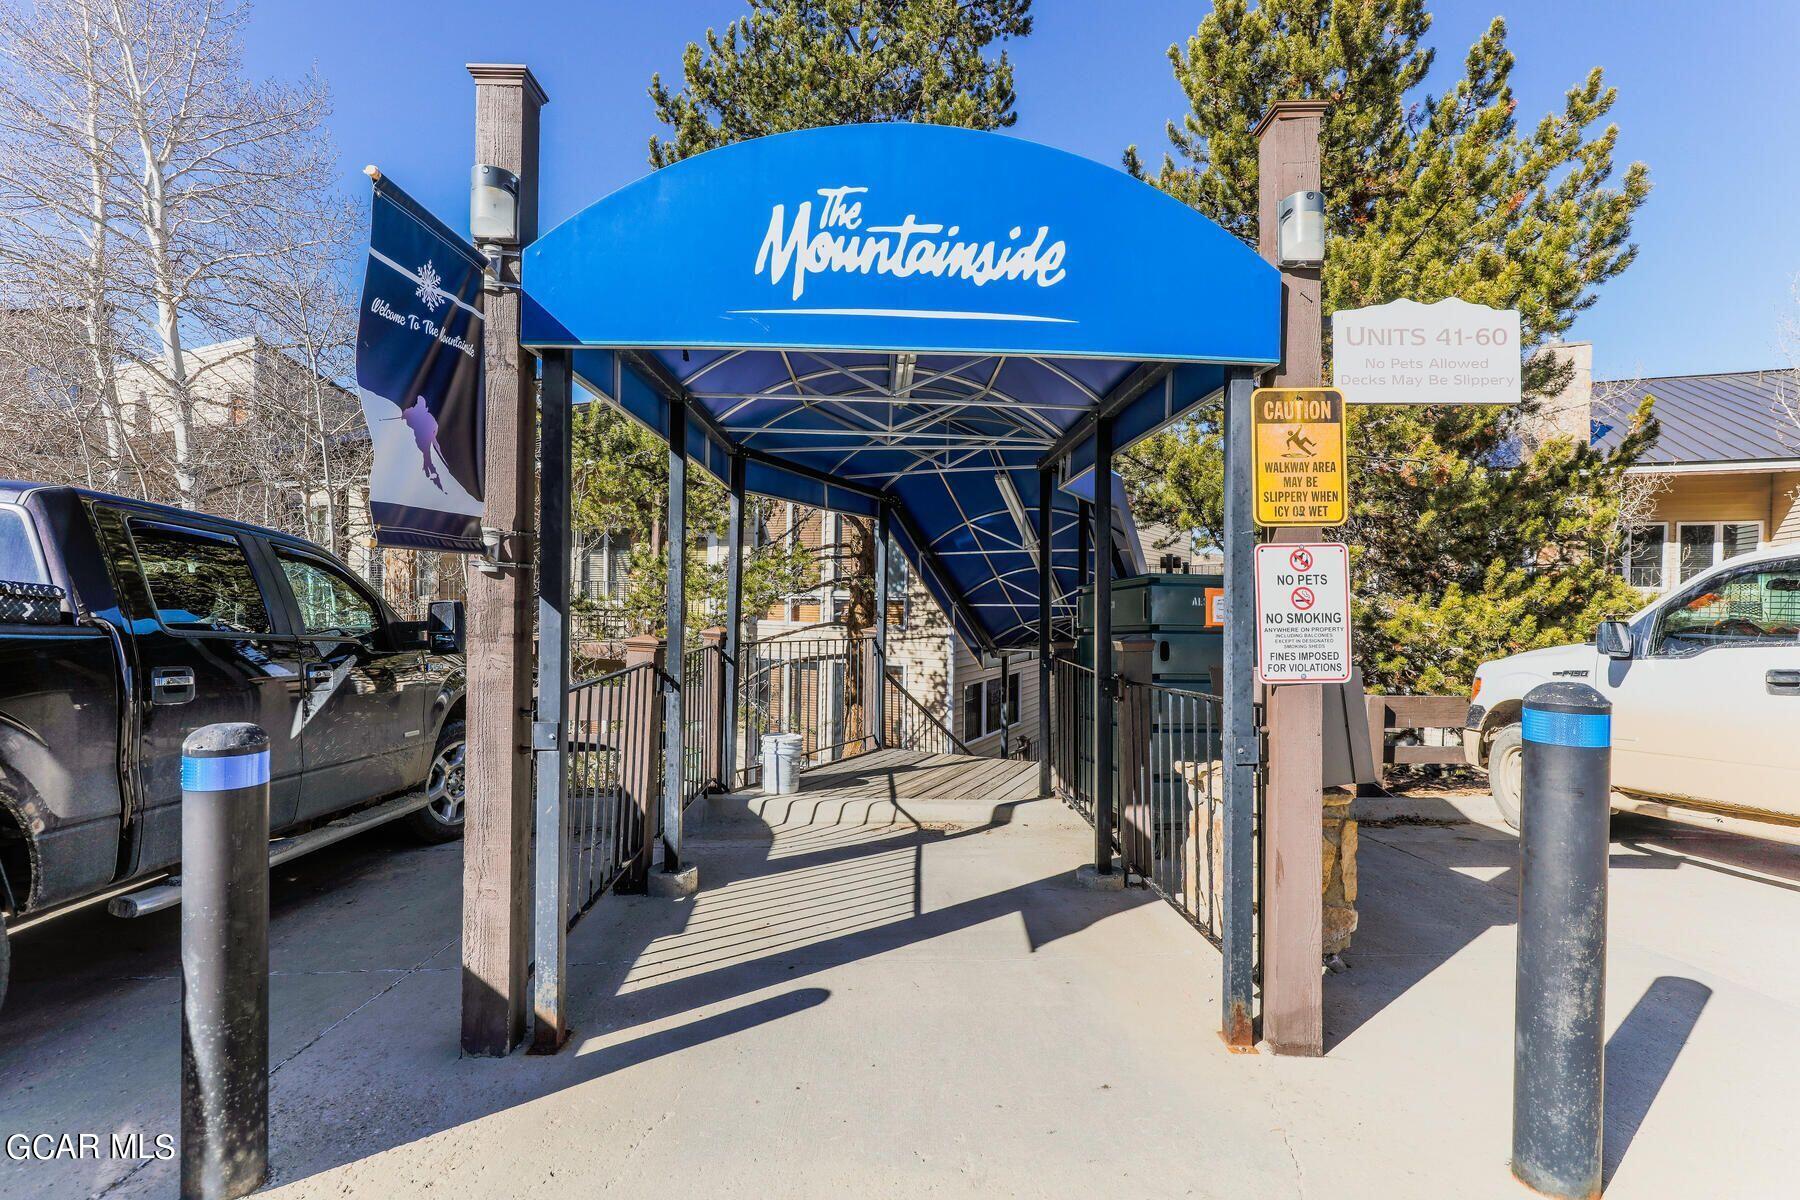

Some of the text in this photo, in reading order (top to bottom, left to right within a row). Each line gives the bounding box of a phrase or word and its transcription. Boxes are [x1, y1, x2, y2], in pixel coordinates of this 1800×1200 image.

[817, 186, 868, 229] The
[754, 201, 1067, 301] Mountainside
[371, 297, 406, 326] Welcome
[408, 314, 420, 330] To
[423, 319, 439, 337] The
[1346, 326, 1508, 346] UNITS 41-60
[1365, 358, 1489, 369] No Pets Allowed
[1341, 374, 1514, 387] Decks May Be Slippery
[1263, 400, 1331, 420] CAUTION
[1264, 461, 1336, 473] WALKWAY AREA
[1283, 476, 1318, 488] MAY BE
[1263, 491, 1338, 503] SLIPPERY WHEN
[1274, 506, 1328, 517] ICY OR WET
[1277, 574, 1328, 586] NO PETS
[1266, 612, 1342, 624] NO SMOKING
[1270, 652, 1340, 661] FINES IMPOSED
[1267, 663, 1342, 673] FOR VIOLATIONS
